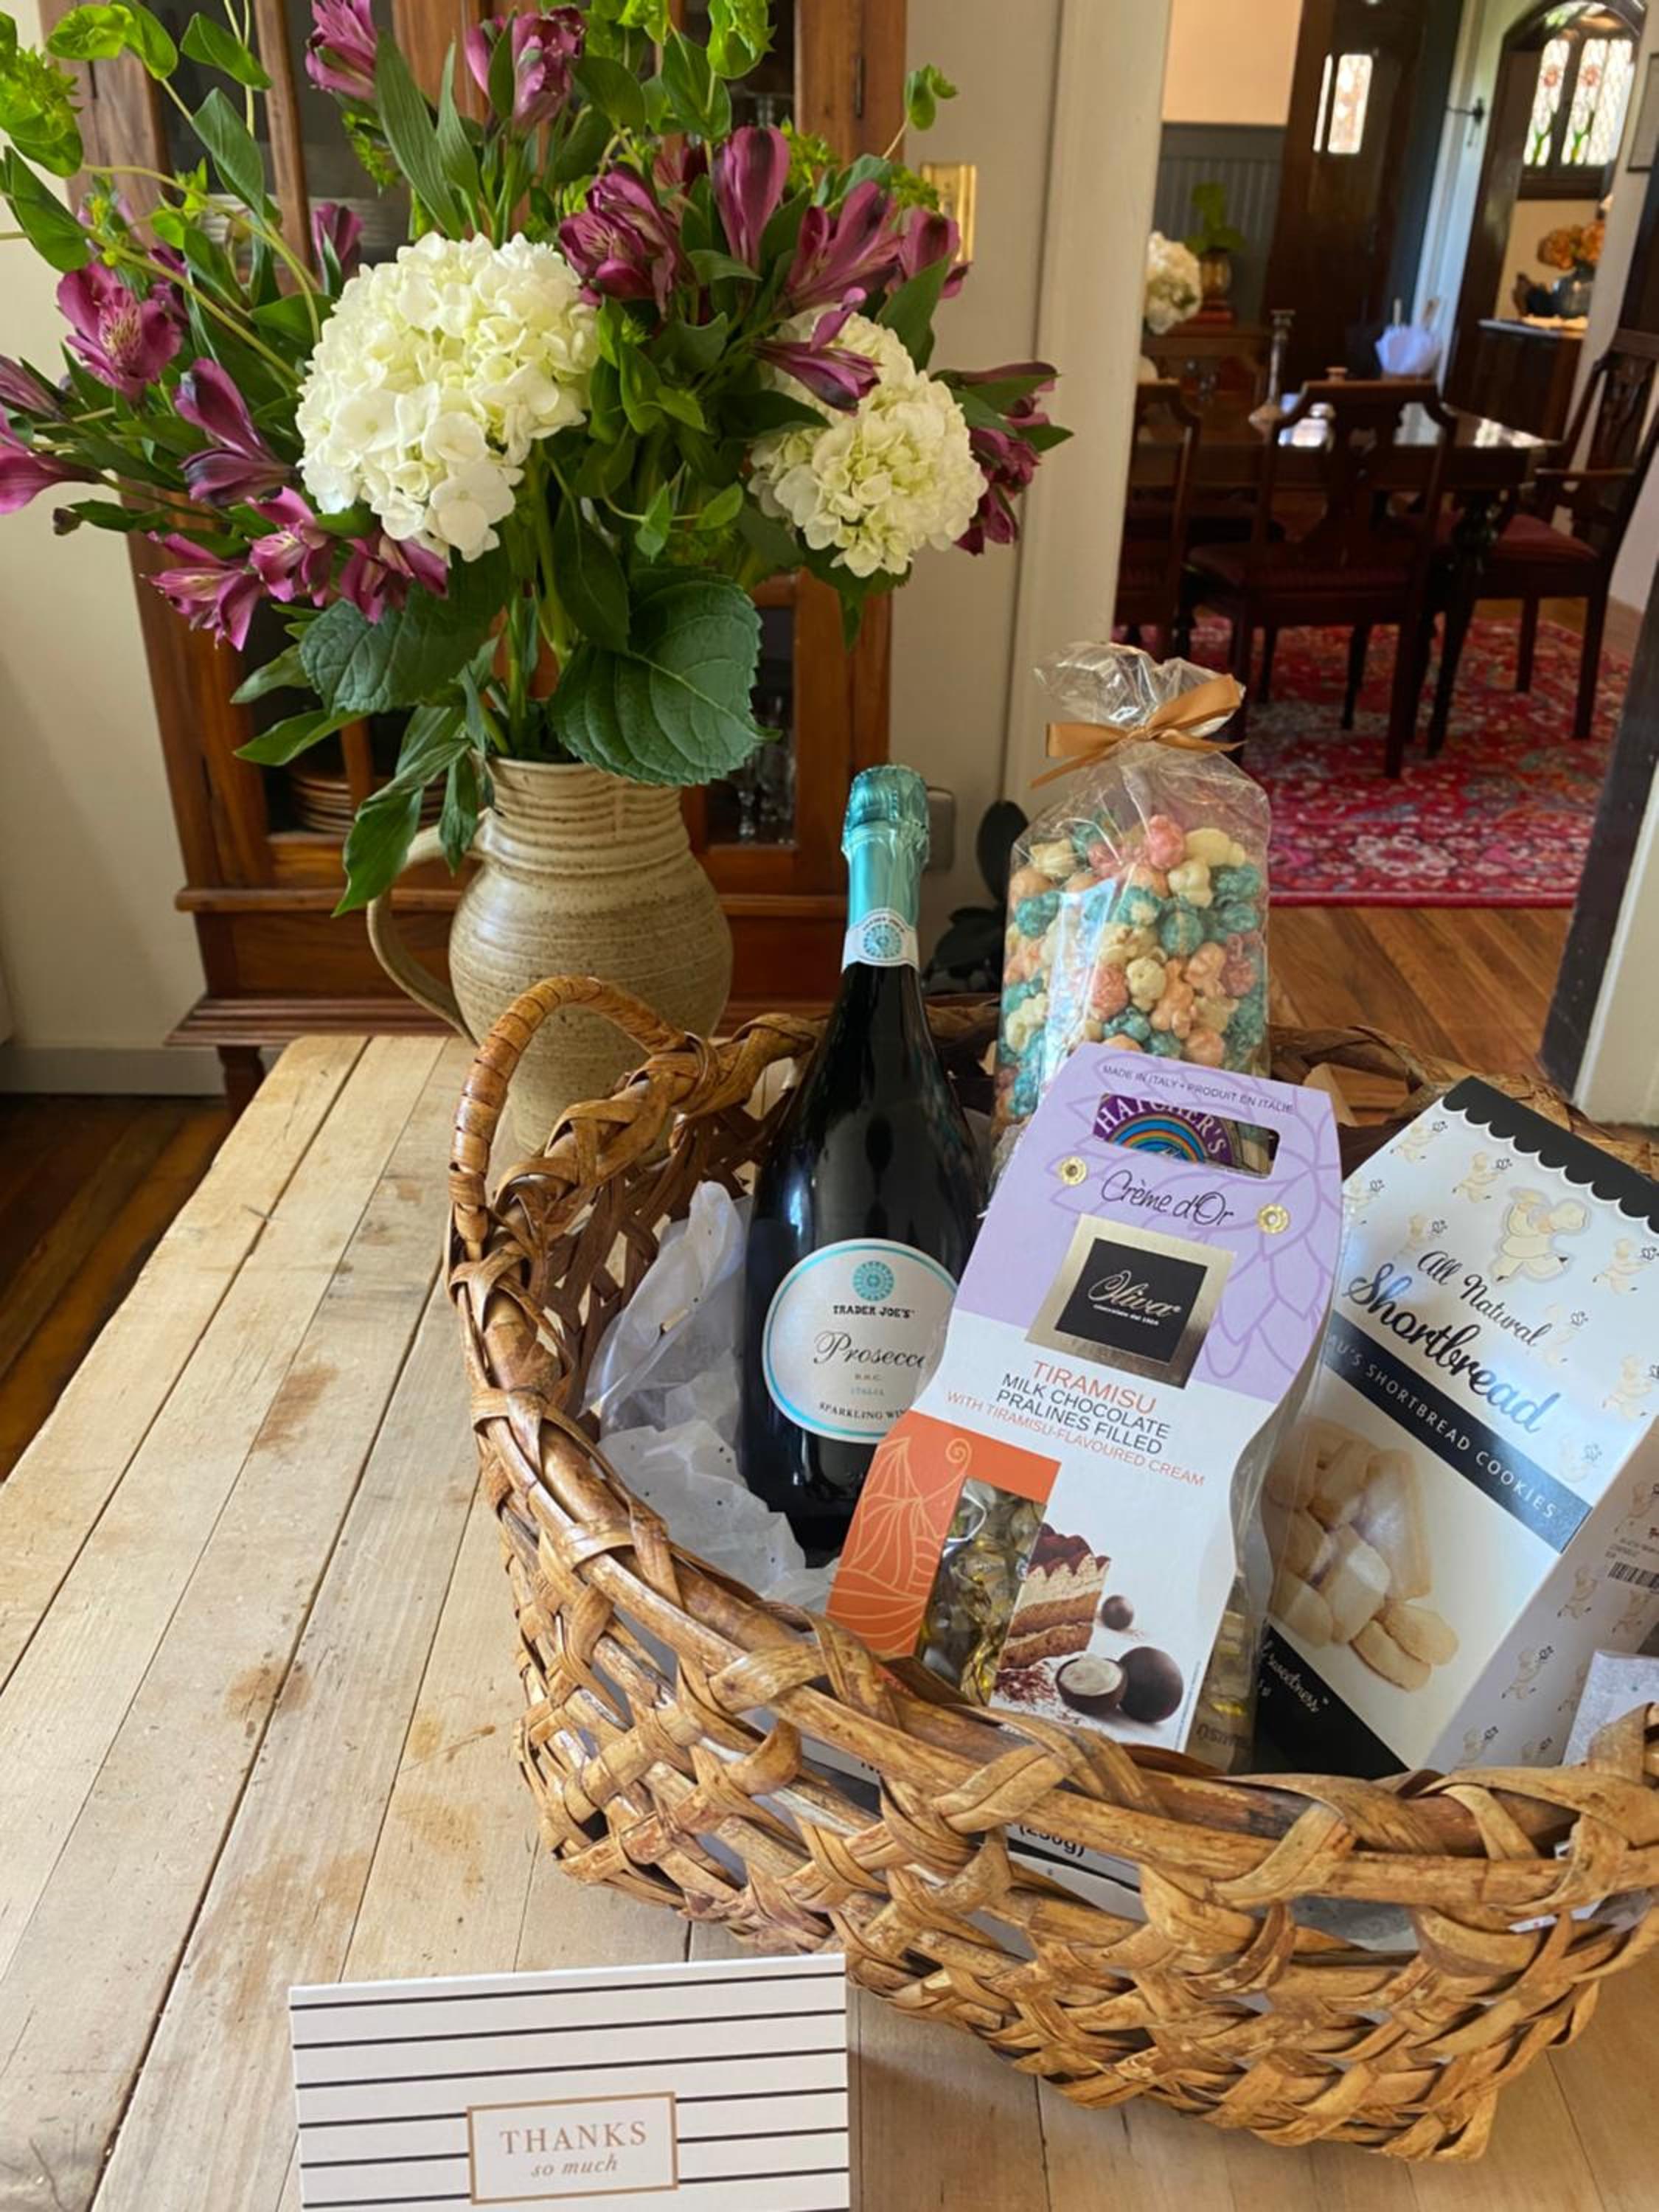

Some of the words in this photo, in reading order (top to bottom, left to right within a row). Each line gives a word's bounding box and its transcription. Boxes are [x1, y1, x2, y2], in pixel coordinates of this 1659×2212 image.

[1135, 1072, 1147, 1083] IN
[1147, 1074, 1178, 1089] ITALY
[1186, 1083, 1237, 1102] PRODUIT
[1239, 1094, 1256, 1105] EN
[1102, 1169, 1172, 1213] Crème
[1172, 1191, 1235, 1226] d'Or
[832, 1305, 876, 1315] TRADER
[879, 1307, 912, 1318] JOE'S
[1416, 1250, 1463, 1287] All
[1459, 1273, 1554, 1348] Natural
[1341, 1262, 1561, 1434] Shortbread
[1002, 1373, 1046, 1399] MILK
[1050, 1390, 1171, 1439] CHOCOLATE
[1033, 1360, 1158, 1416] TIRAMISU
[947, 1391, 984, 1411] WITH
[986, 1405, 1145, 1468] TIRAMISU-FLAVOURED
[1148, 1459, 1206, 1486] CREAM
[995, 1389, 1091, 1433] PRALINES
[1094, 1421, 1163, 1455] FILLED
[1365, 1362, 1470, 1452] SHORTBREAD
[1475, 1450, 1559, 1520] COOKIES
[499, 2121, 647, 2155] THANKS
[531, 2164, 554, 2177] so
[561, 2153, 619, 2175] much
